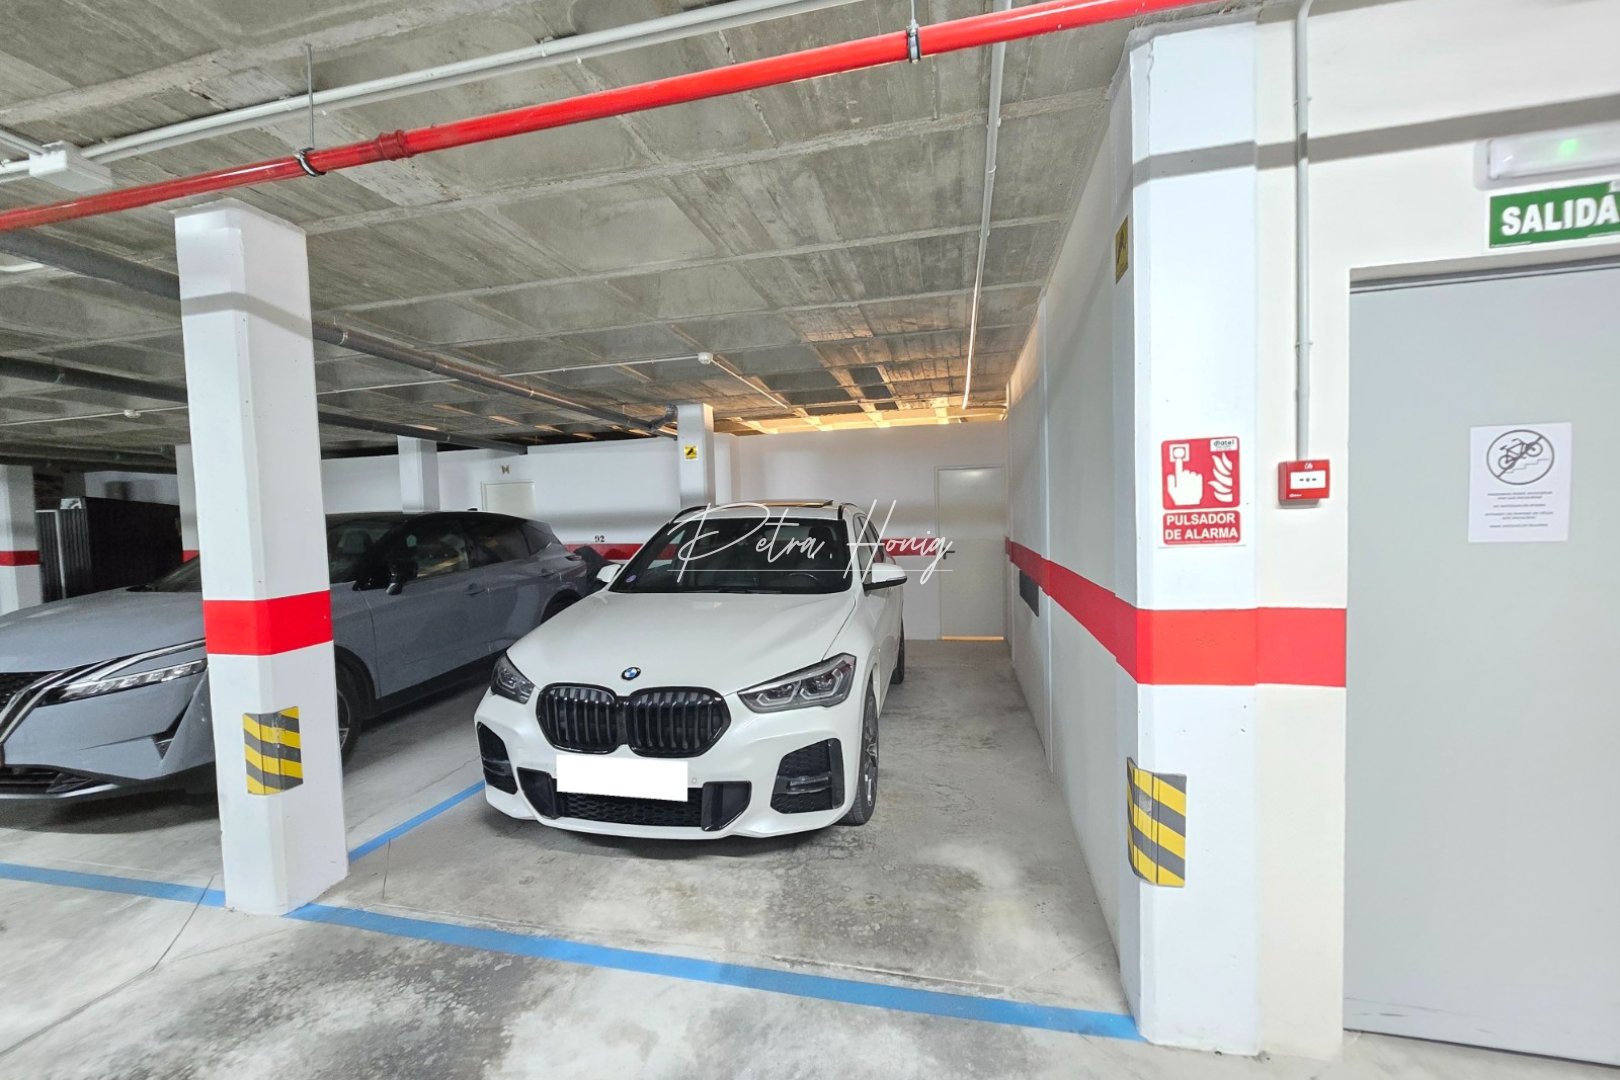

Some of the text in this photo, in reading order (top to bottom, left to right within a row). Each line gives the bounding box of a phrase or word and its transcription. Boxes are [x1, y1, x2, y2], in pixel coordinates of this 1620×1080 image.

[1501, 194, 1620, 236] SALIDA
[1166, 511, 1236, 526] PULSADOR
[1165, 527, 1239, 540] DE ALARMA
